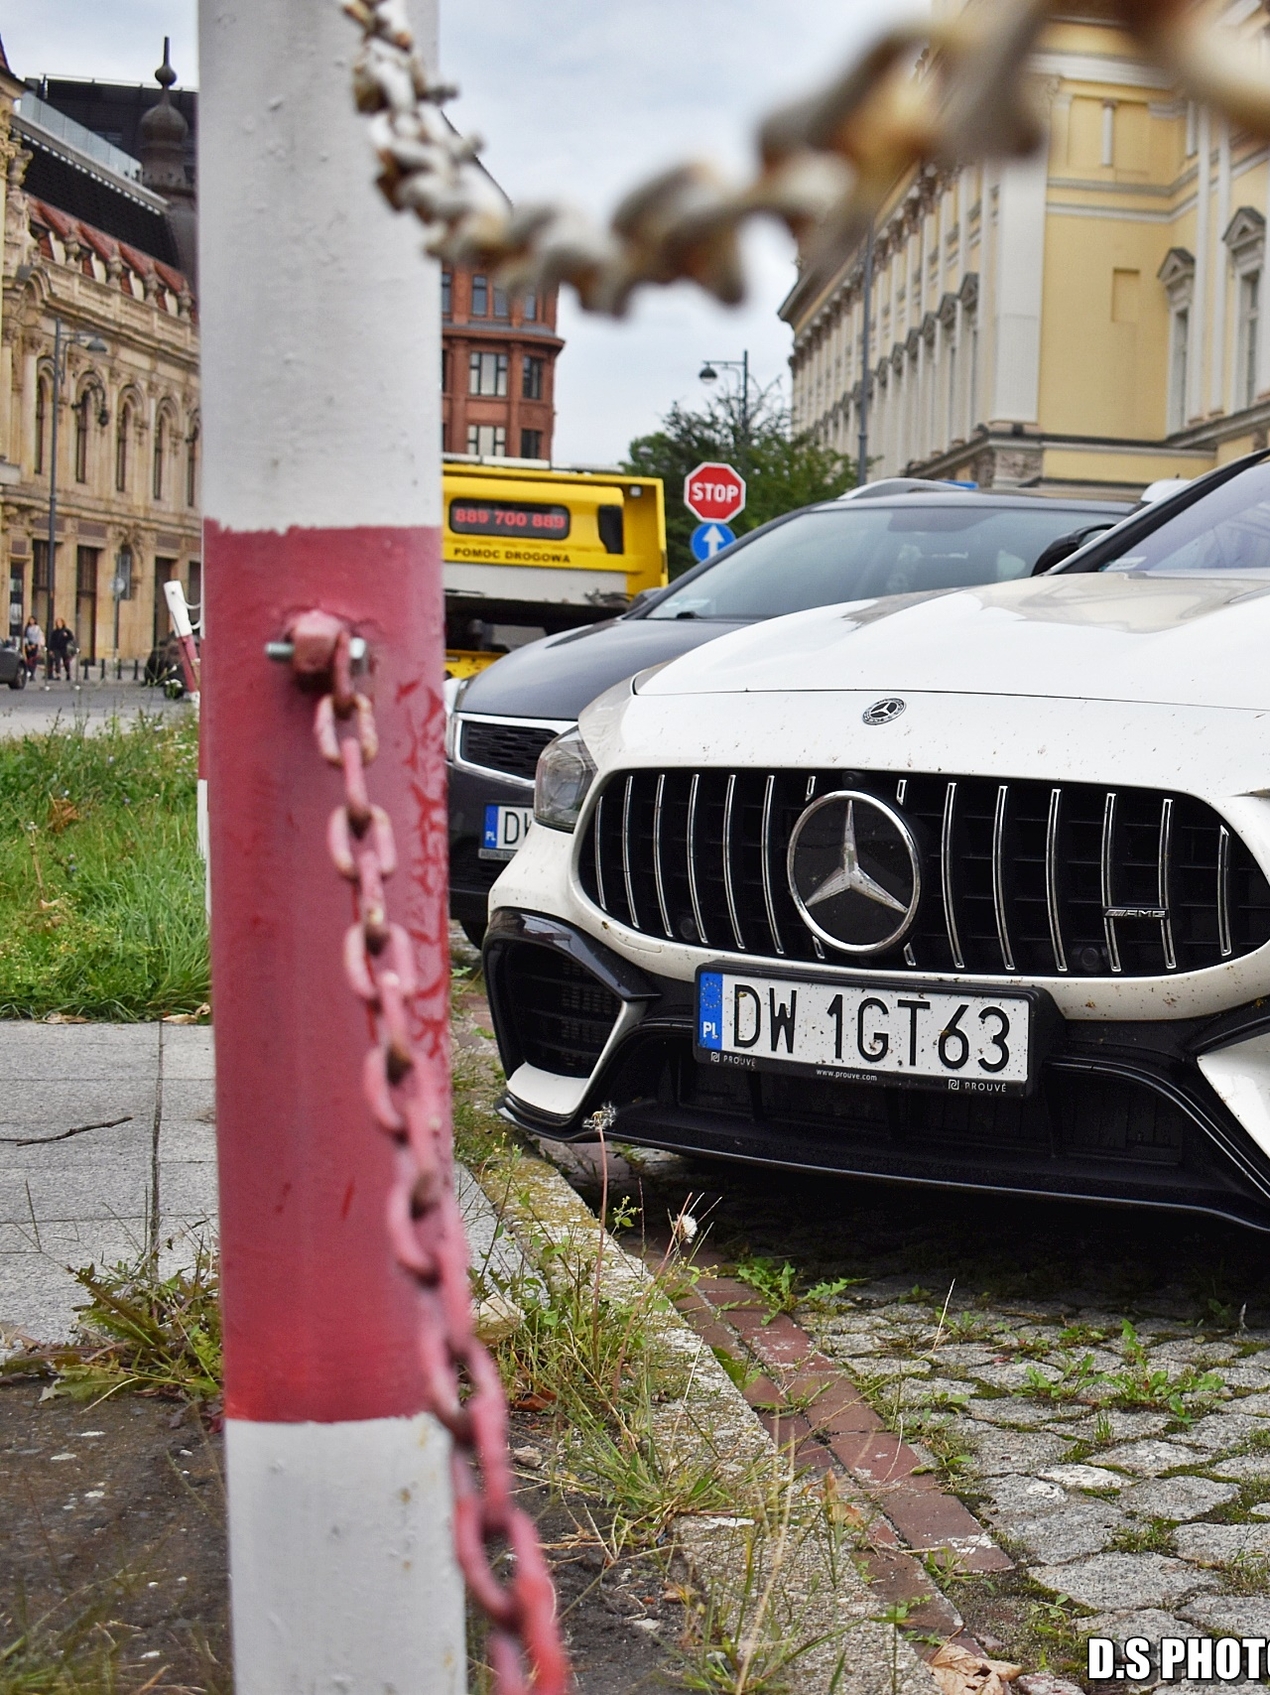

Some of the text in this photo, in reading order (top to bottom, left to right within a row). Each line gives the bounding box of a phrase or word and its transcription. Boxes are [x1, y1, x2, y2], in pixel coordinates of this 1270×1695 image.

[691, 482, 739, 503] STOP
[455, 508, 566, 529] 889 700 889
[454, 547, 571, 563] POMOC DROGOWA
[703, 1021, 718, 1039] PL
[733, 984, 1010, 1073] DW 1GT63
[816, 1068, 878, 1082] www.prouve.com
